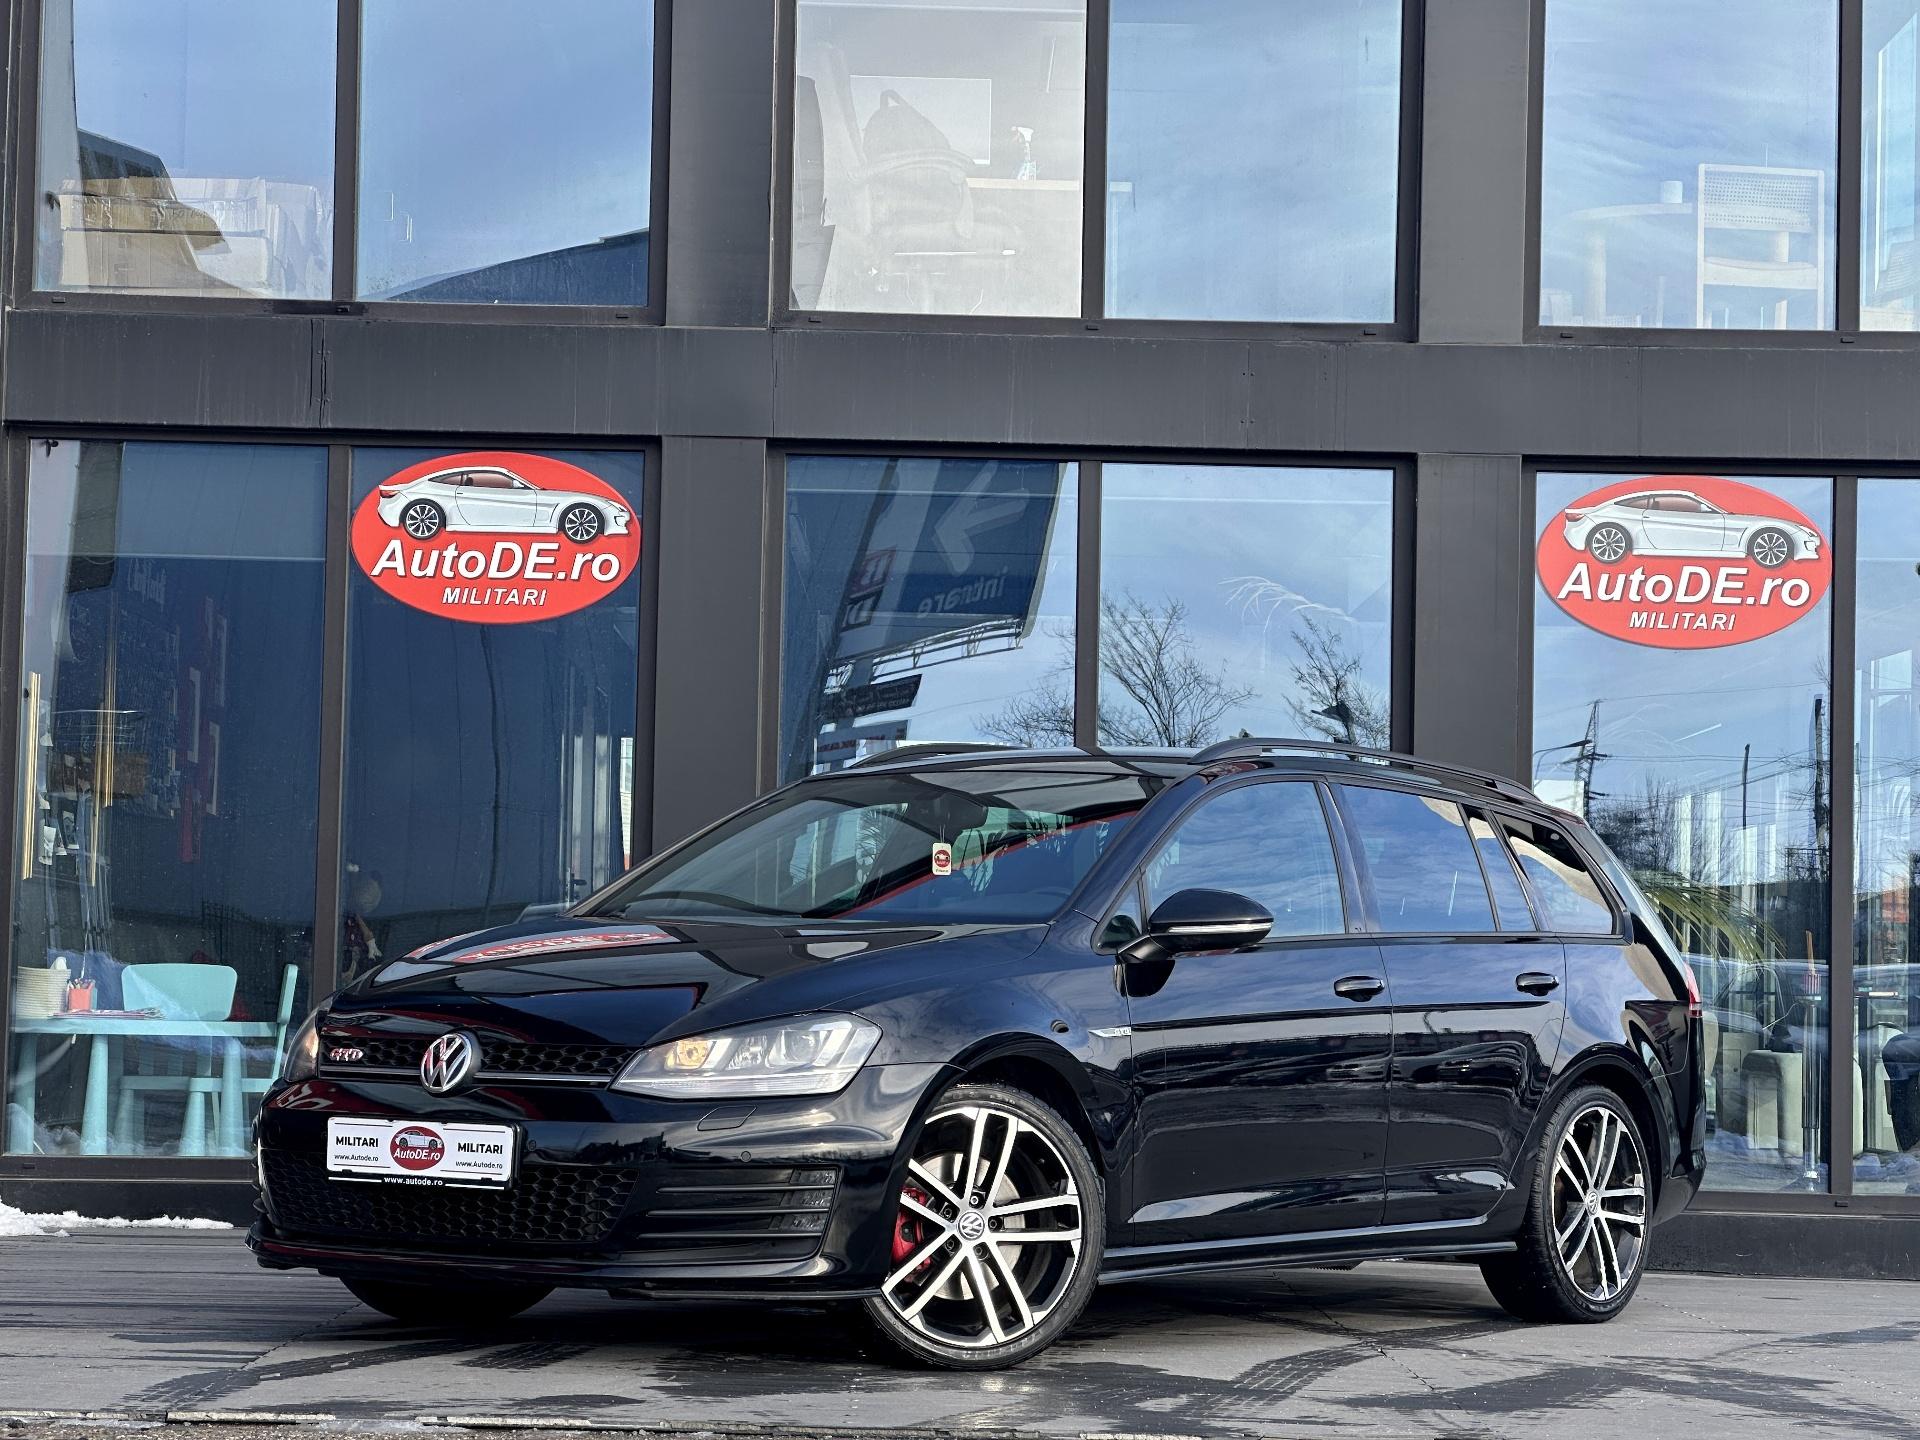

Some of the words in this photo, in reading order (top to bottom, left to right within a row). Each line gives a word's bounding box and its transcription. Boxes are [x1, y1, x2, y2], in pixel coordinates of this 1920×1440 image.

[370, 539, 621, 581] AutoDE.ro
[1557, 562, 1812, 607] AutoDE.ro
[442, 587, 547, 606] MILITARI
[1629, 611, 1736, 631] MILITARI
[335, 1136, 379, 1148] MILITARI
[393, 1148, 441, 1161] AutoDE.ro
[457, 1143, 503, 1155] MILITARI
[334, 1154, 379, 1162] www.Autode.ro
[455, 1160, 503, 1170] www.Autode.ro
[383, 1176, 443, 1187] www.autode.ro
